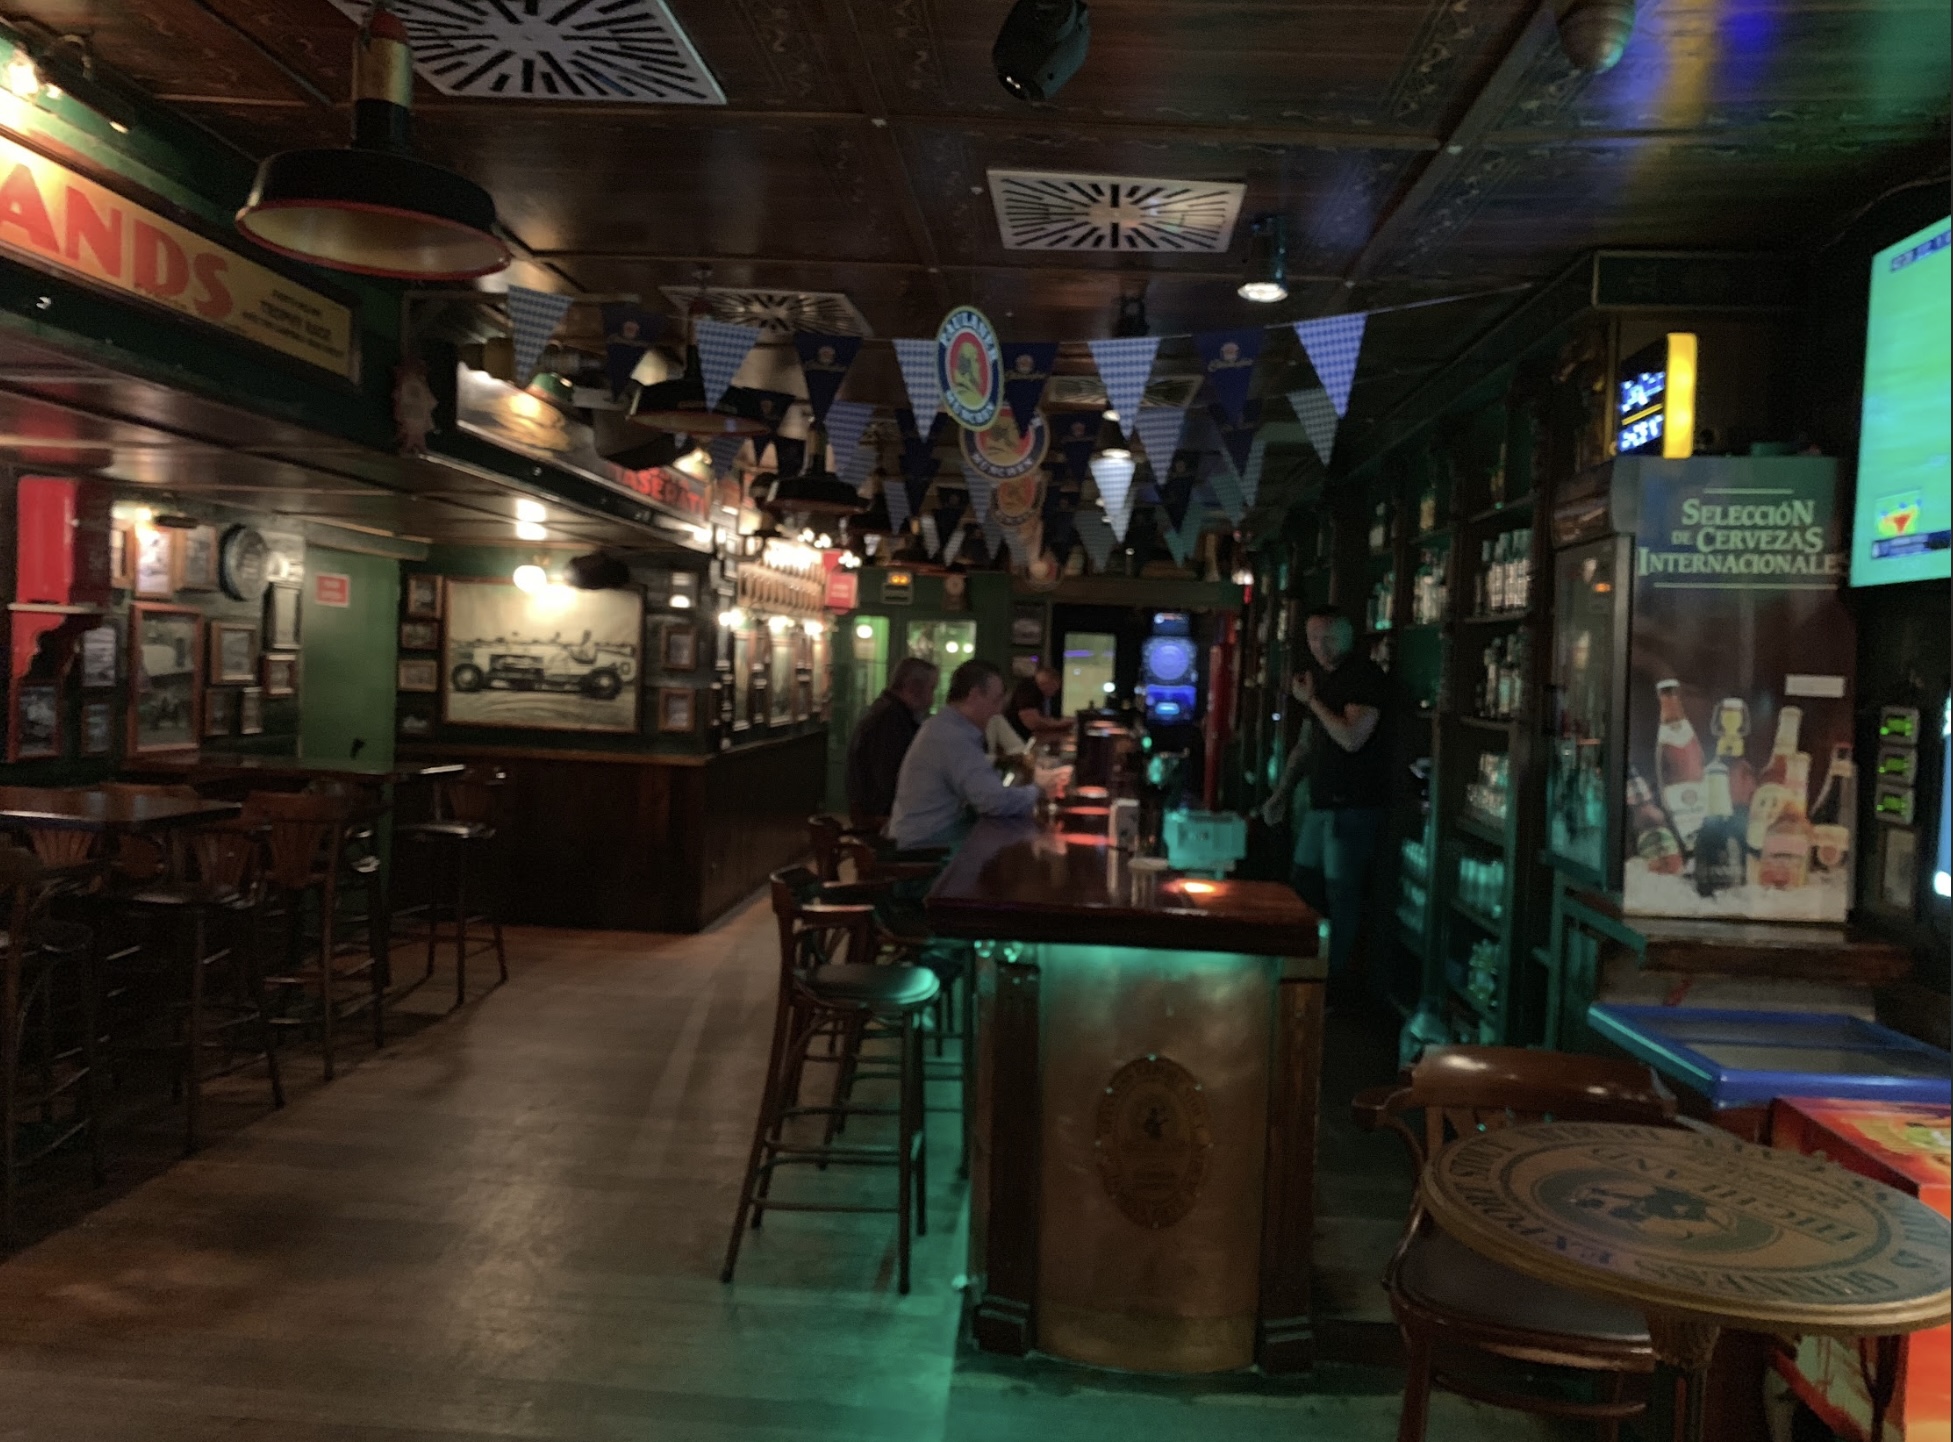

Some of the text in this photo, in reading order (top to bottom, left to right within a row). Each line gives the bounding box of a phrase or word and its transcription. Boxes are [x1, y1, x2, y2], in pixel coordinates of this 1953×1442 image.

[938, 312, 999, 361] PAULANER
[1681, 498, 1815, 526] SELECCIÓN
[1671, 526, 1824, 553] DE CERVEZAS
